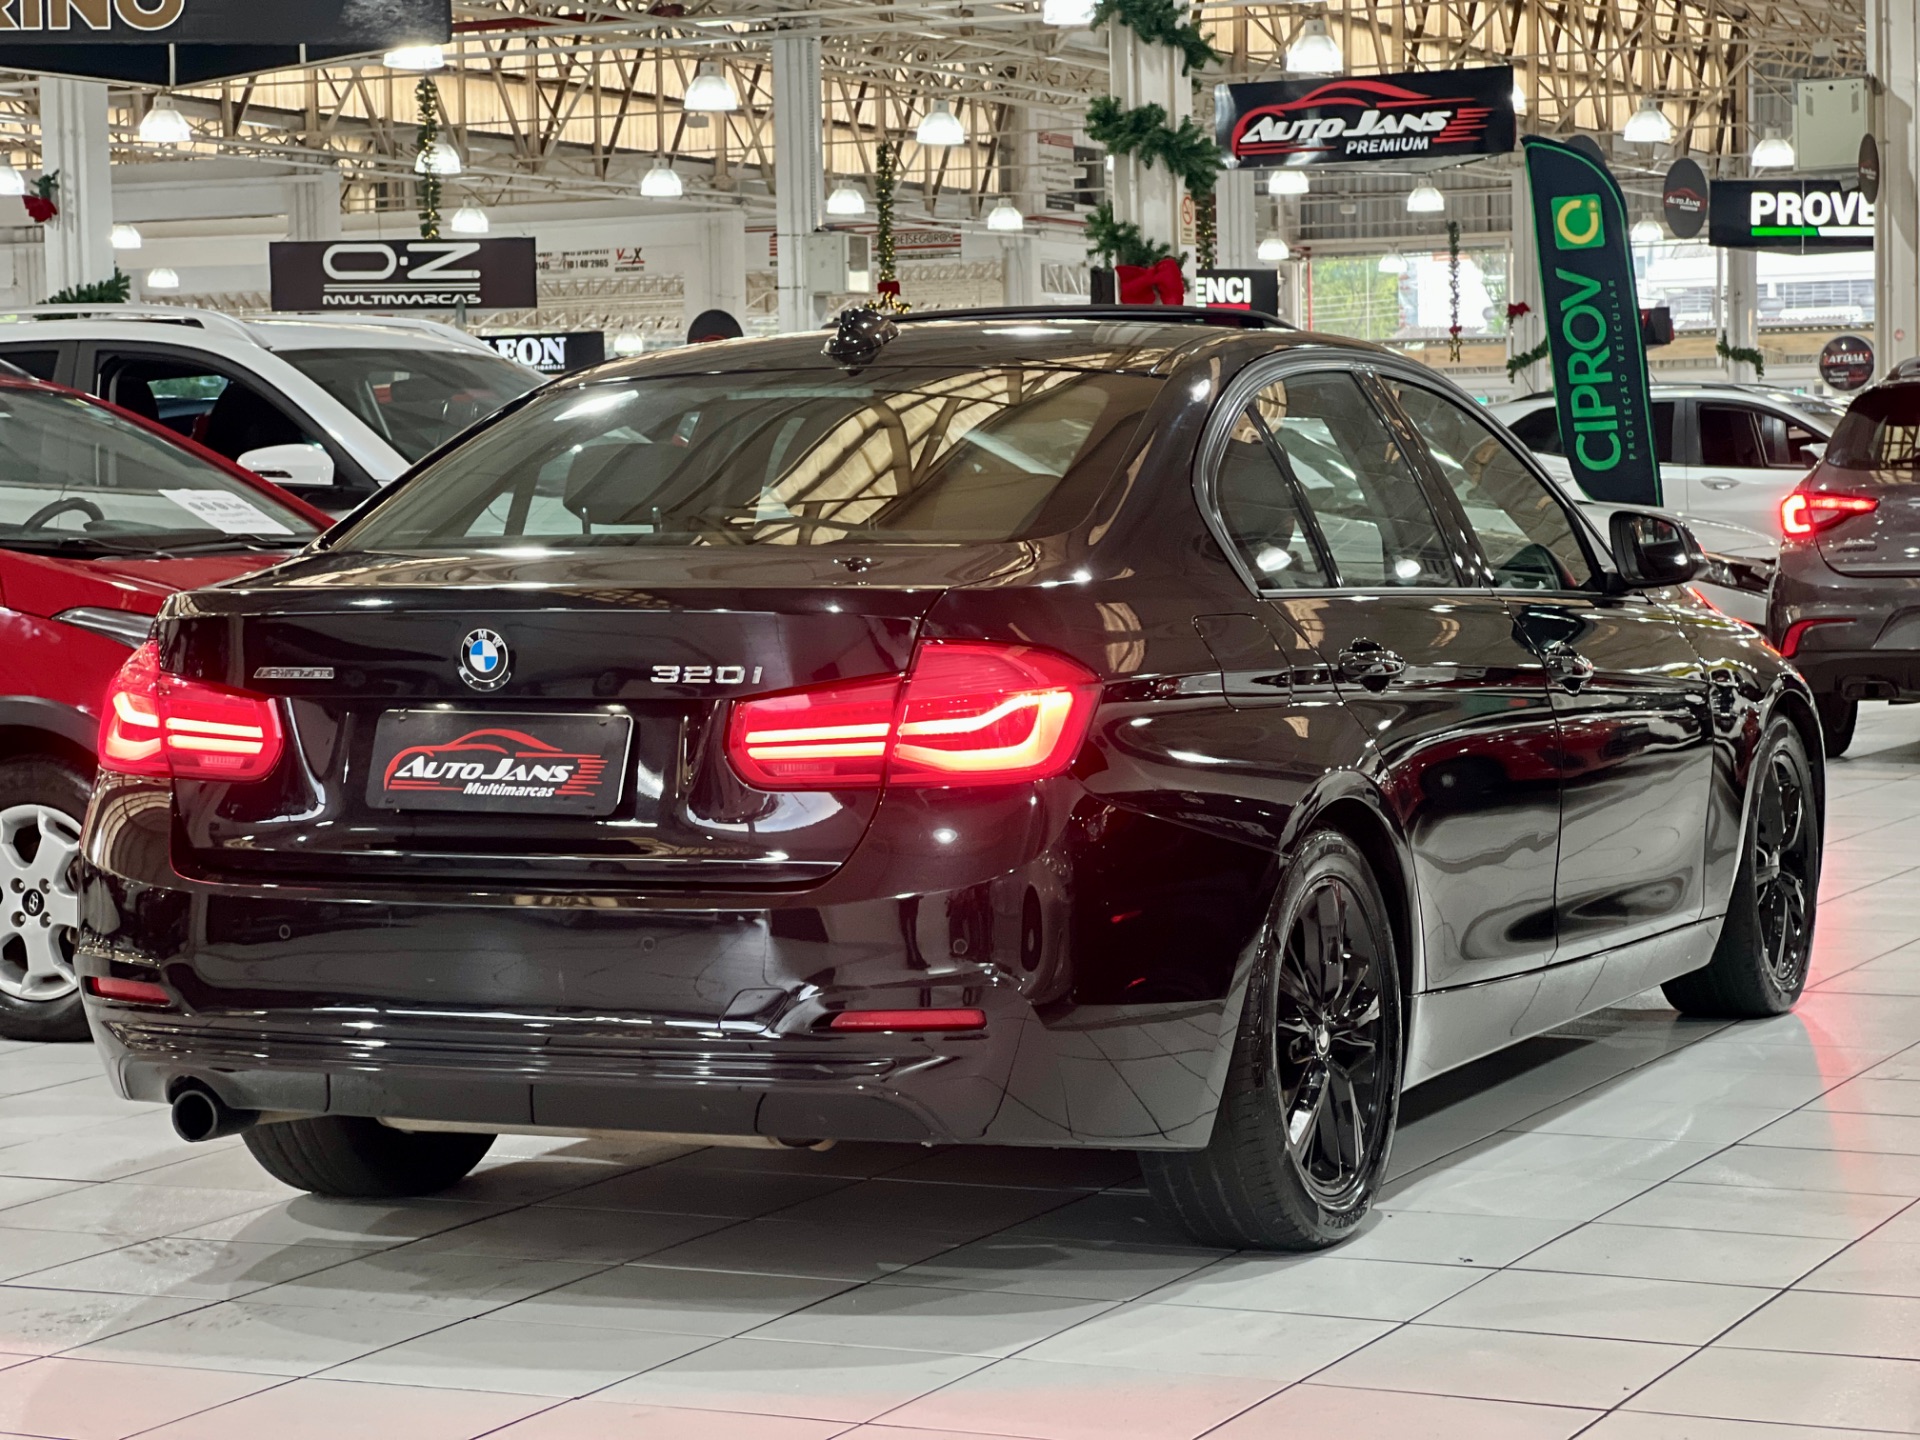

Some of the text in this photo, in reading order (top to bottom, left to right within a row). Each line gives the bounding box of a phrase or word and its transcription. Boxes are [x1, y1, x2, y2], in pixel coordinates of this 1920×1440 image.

[1346, 136, 1429, 154] PREMIUM
[322, 294, 482, 305] MULTIMARCAS
[1608, 279, 1626, 363] VEICULAR
[482, 336, 567, 366] EON
[1555, 267, 1622, 472] CIPROV
[463, 782, 556, 797] Multimarcas
